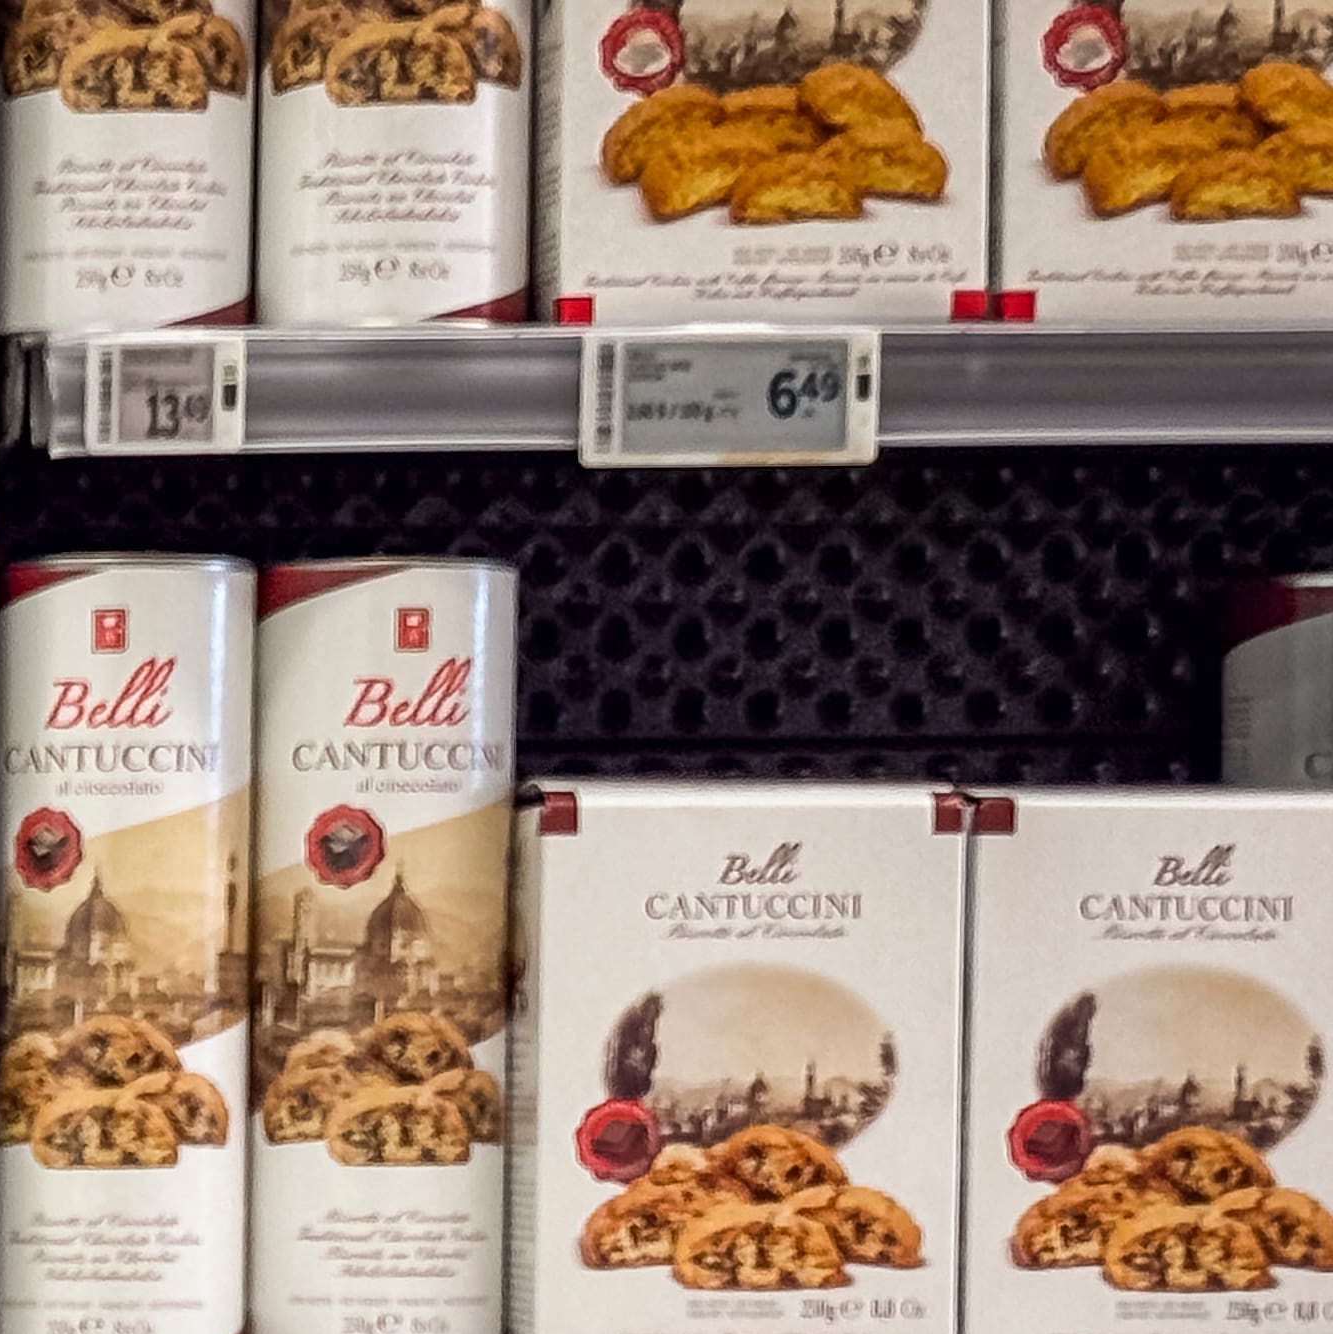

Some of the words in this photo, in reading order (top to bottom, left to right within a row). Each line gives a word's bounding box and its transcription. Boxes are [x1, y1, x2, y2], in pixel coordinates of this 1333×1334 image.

[44, 656, 178, 730] Belli
[344, 656, 472, 728] Belli
[4, 742, 220, 776] CANTUCCINI
[718, 841, 803, 886] Belli
[1153, 843, 1237, 888] Belli
[644, 892, 863, 920] CANTUCCINI
[1078, 894, 1295, 922] CANTUCCINI
